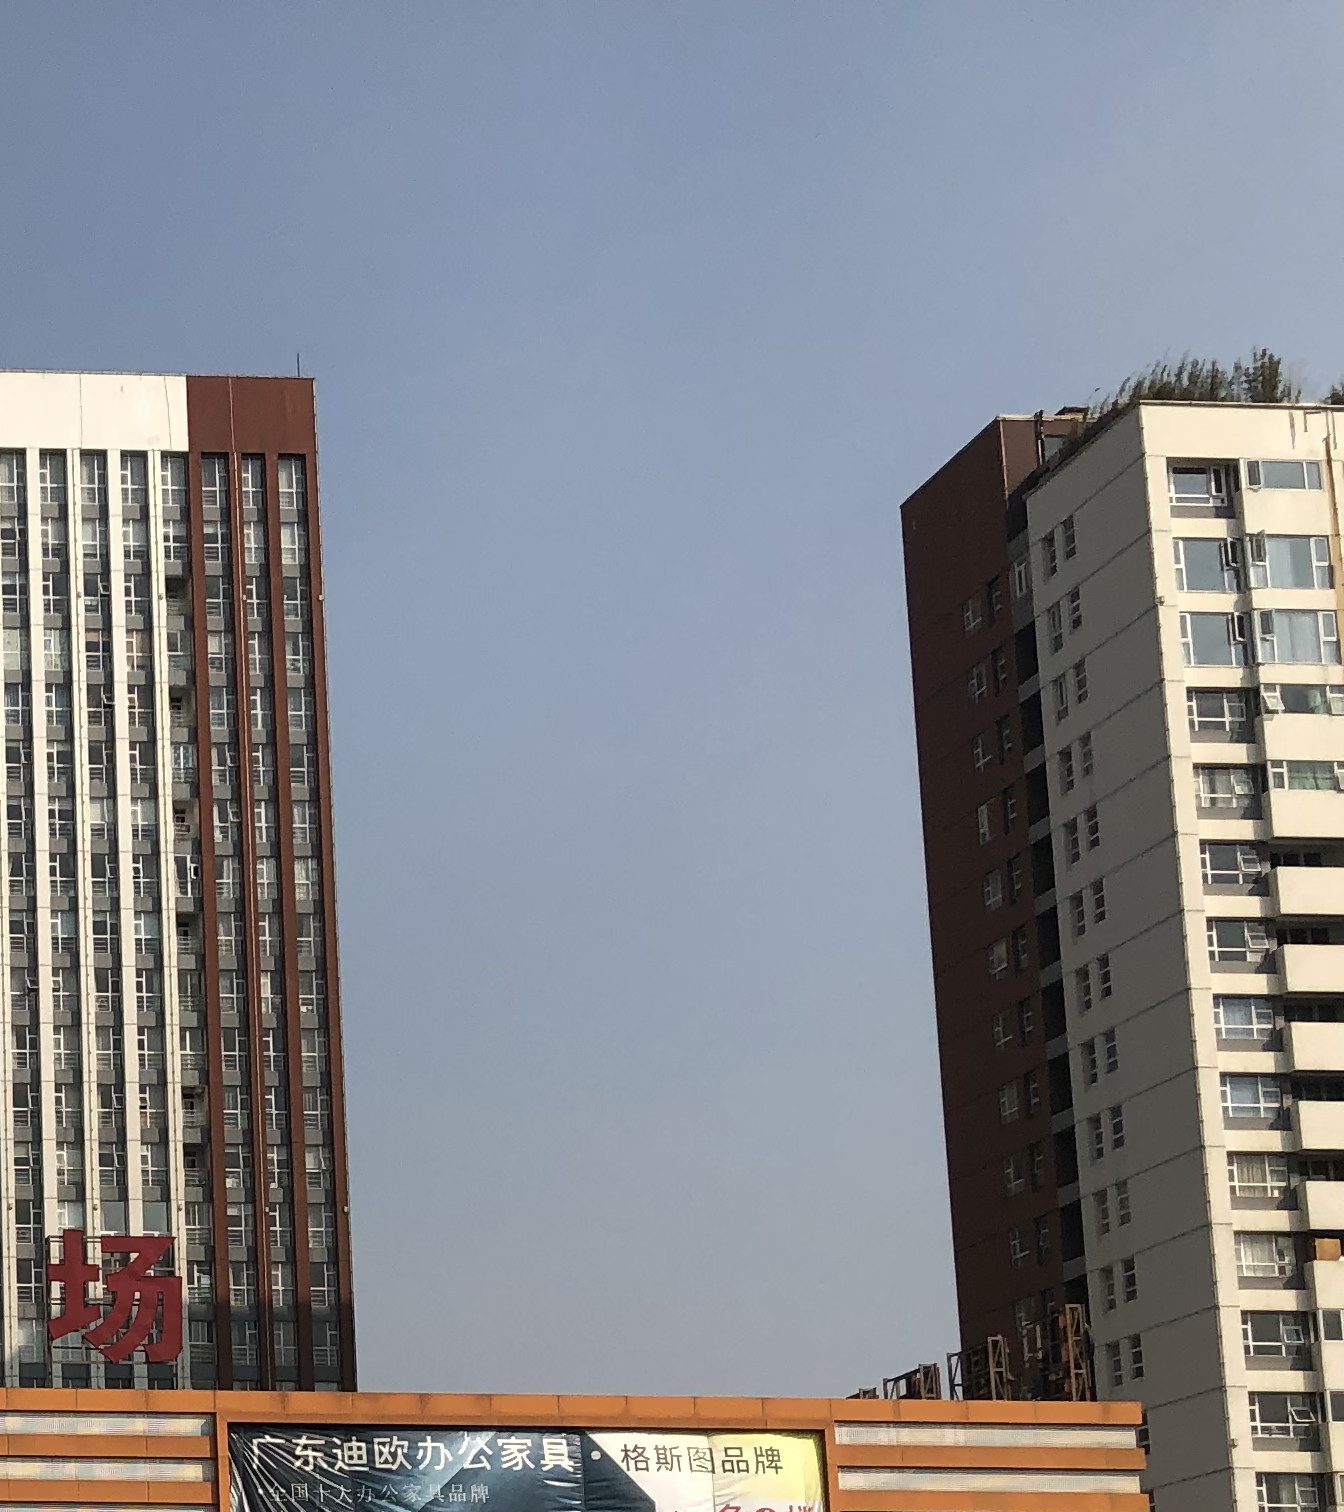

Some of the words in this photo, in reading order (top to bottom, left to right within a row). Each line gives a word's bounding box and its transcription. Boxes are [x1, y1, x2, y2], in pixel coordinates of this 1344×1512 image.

[250, 1433, 576, 1473] 广东迪欧办公家具
[620, 1443, 784, 1475] 格斯图品牌
